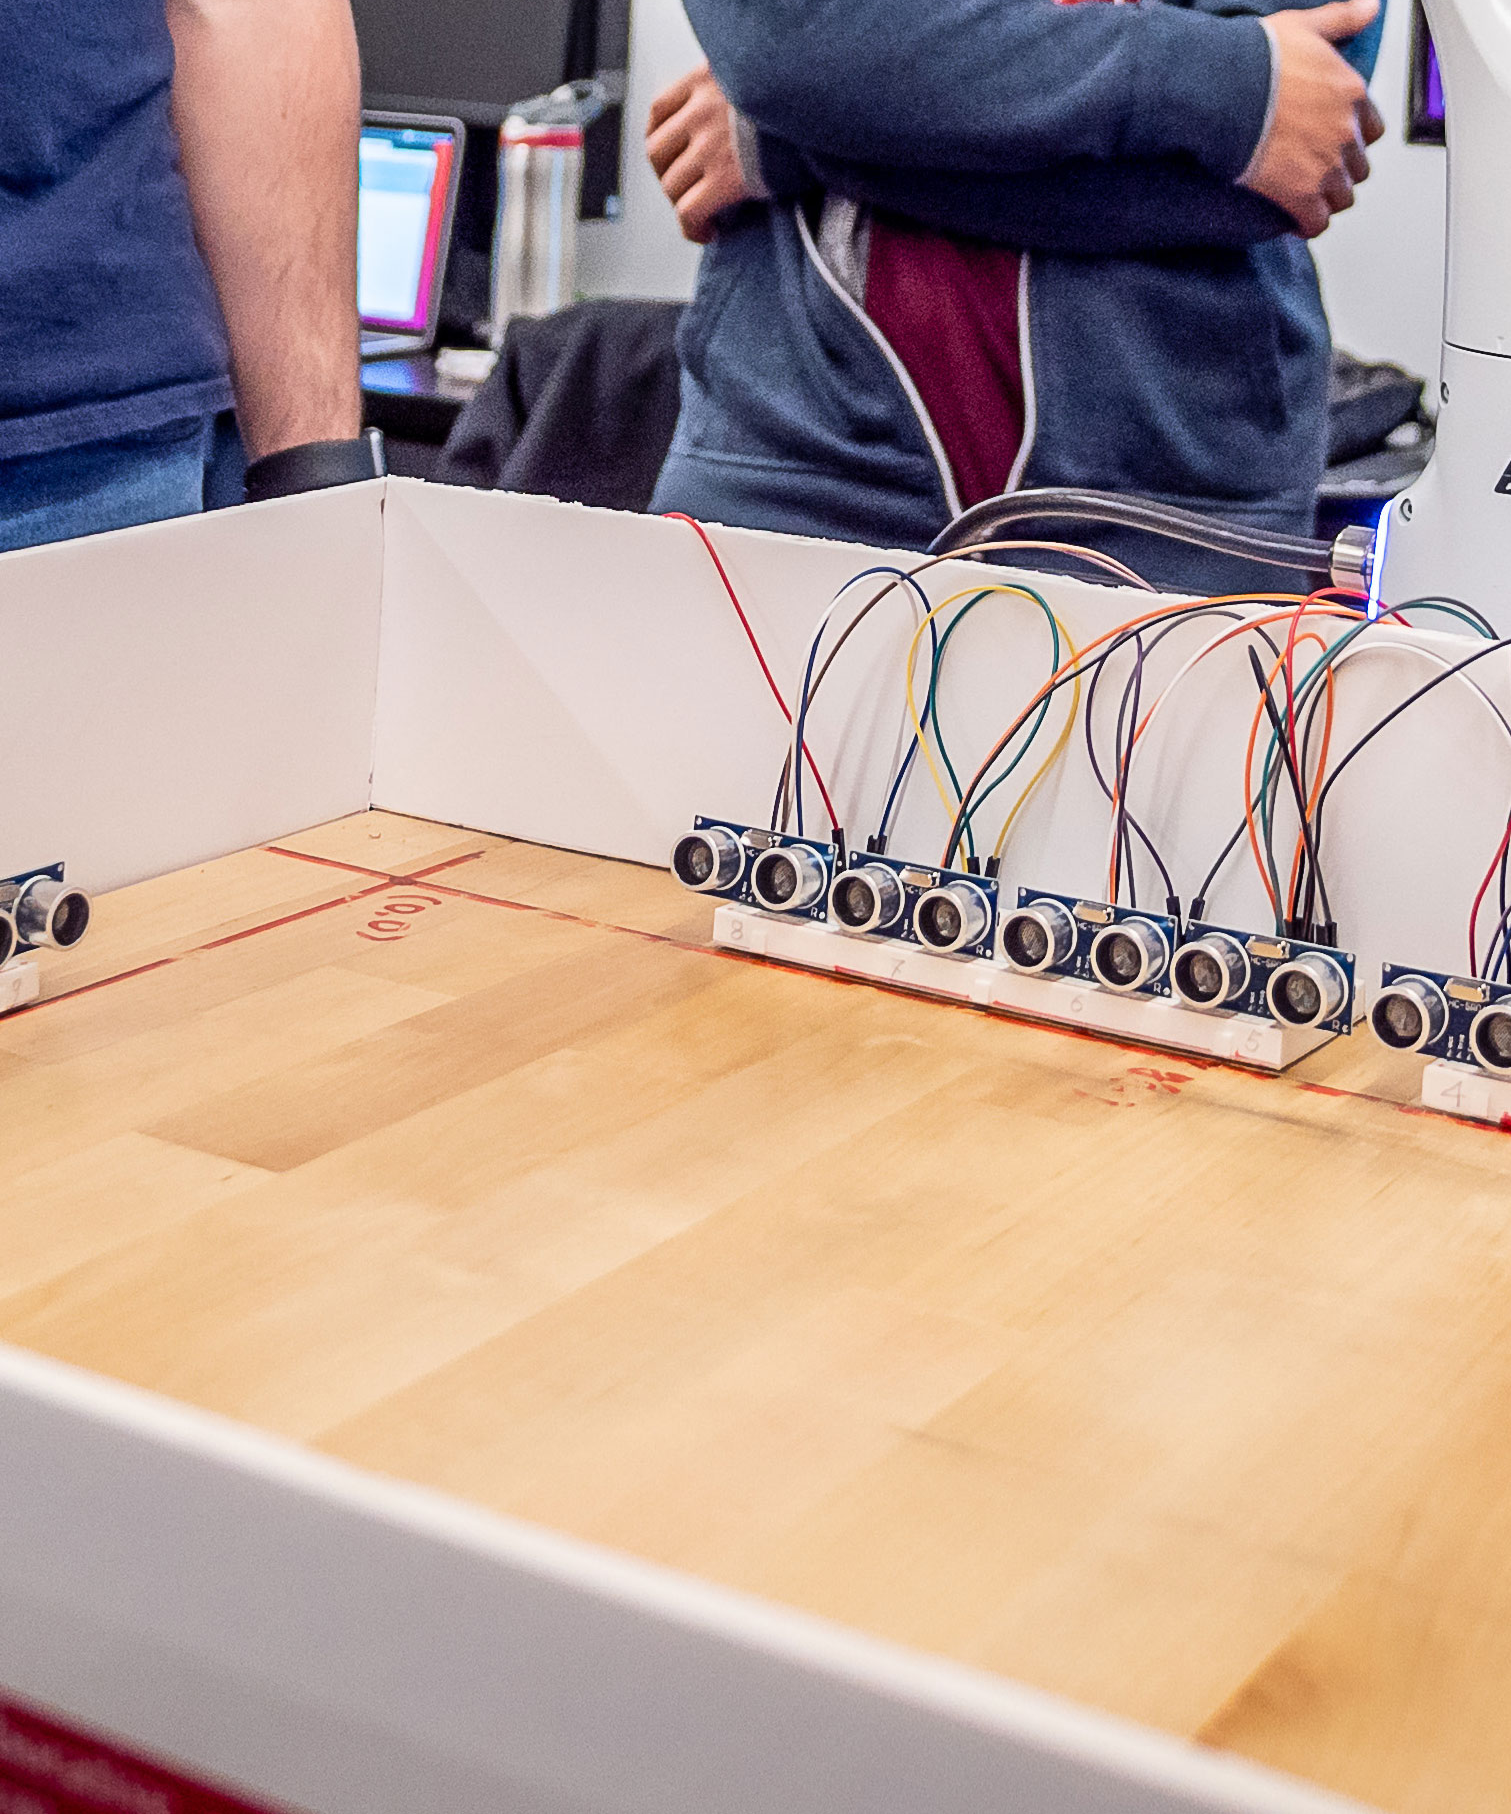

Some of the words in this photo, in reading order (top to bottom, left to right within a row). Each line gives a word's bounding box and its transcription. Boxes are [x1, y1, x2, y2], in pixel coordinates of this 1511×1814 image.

[731, 919, 744, 940] 8
[1070, 995, 1083, 1013] 6
[1440, 1080, 1465, 1108] 4
